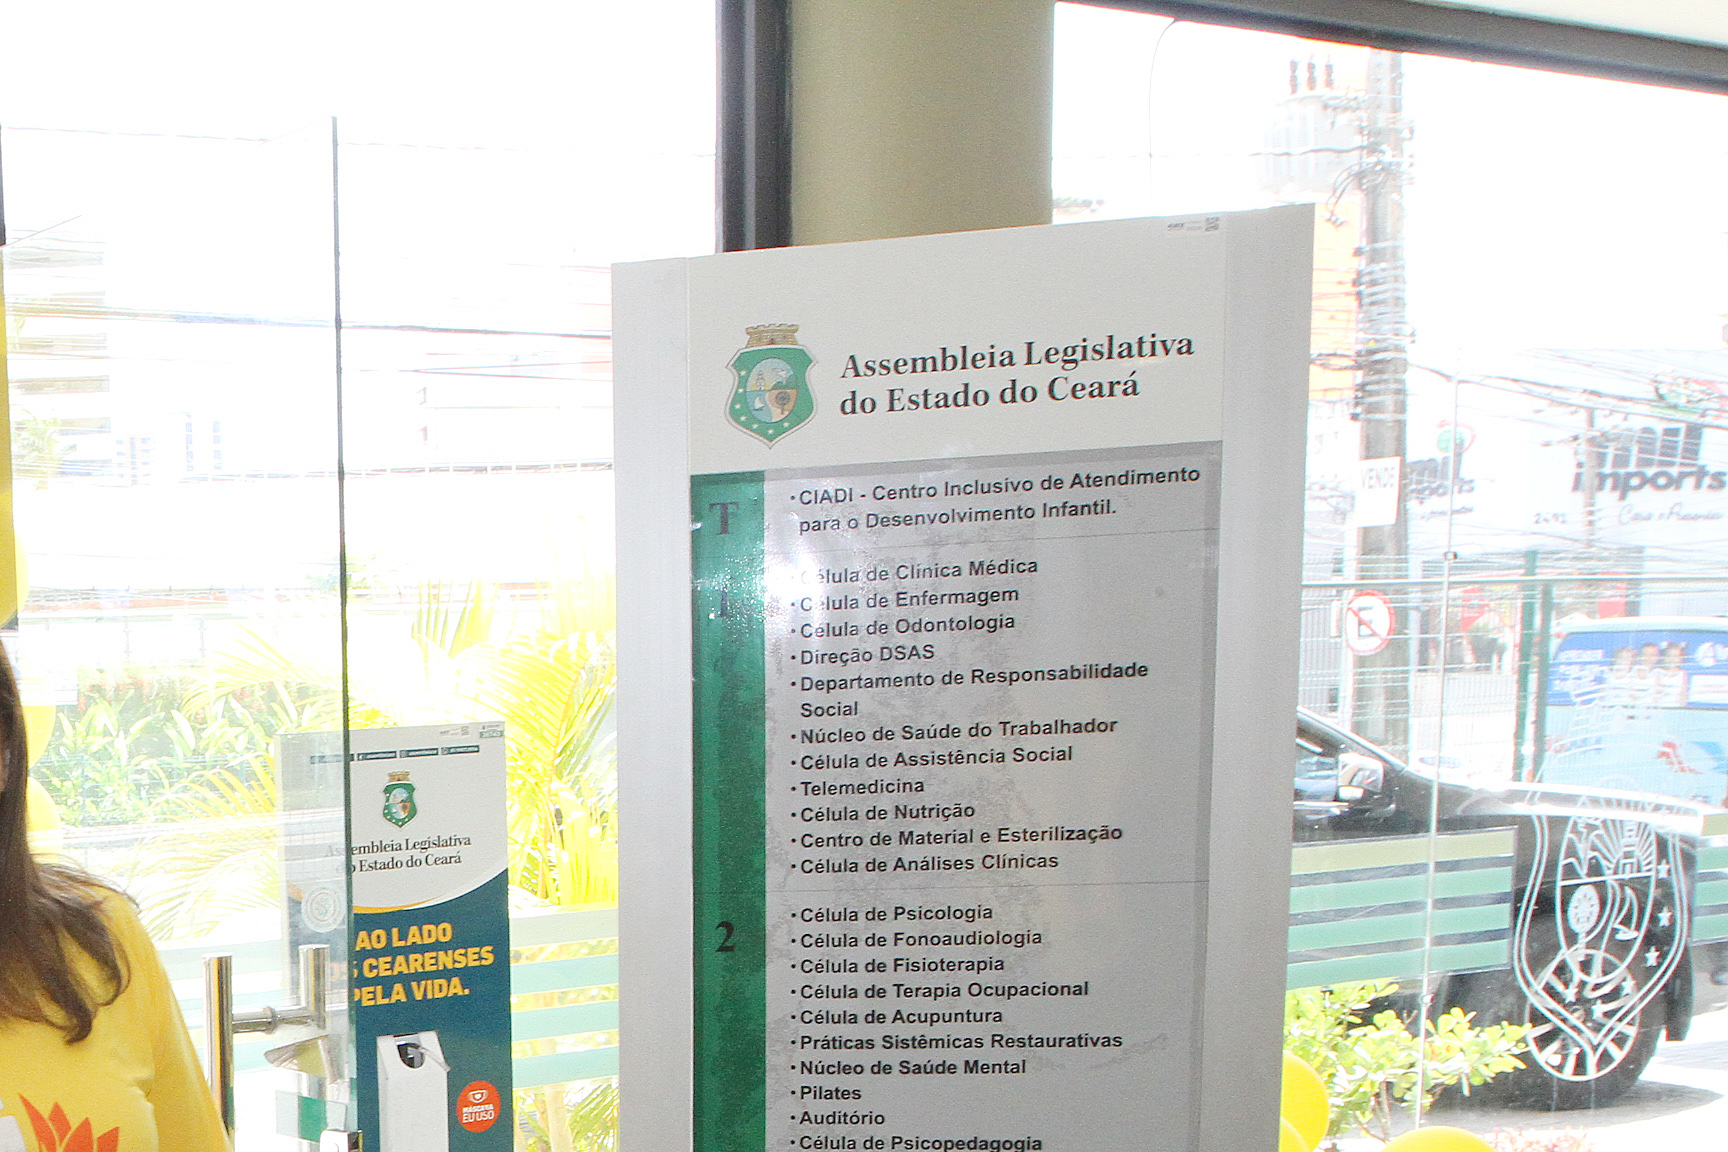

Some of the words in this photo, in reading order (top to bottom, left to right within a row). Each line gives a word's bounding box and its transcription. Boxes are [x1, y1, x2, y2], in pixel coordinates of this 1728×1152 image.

[841, 344, 1016, 380] Assembleia
[1025, 335, 1195, 371] Legislativa
[841, 389, 877, 416] do
[886, 382, 990, 413] Estado
[999, 379, 1038, 404] do
[1048, 371, 1140, 401] Ceará
[799, 489, 853, 506] CIADI
[872, 484, 937, 501] Centro
[944, 478, 1033, 496] Inclusivo
[1041, 474, 1064, 490] de
[1070, 467, 1200, 488] Atendimento
[708, 502, 739, 536] T
[799, 517, 840, 535] para
[848, 518, 859, 530] o
[867, 504, 1035, 528] Desenvolvimento
[1042, 500, 1116, 518] Infantil.
[866, 566, 889, 581] de
[896, 561, 962, 579] Clínica
[969, 559, 1038, 576] Médica
[866, 593, 889, 608] de
[896, 587, 1019, 606] Enfermagem
[800, 621, 859, 638] Célula
[866, 620, 888, 635] de
[896, 615, 1015, 633] Odontologia
[801, 648, 872, 667] Direção
[881, 644, 935, 660] DSAS
[801, 671, 935, 694] Departamento
[942, 670, 964, 686] de
[972, 662, 1148, 688] Responsabilidade
[801, 701, 858, 717] Social
[801, 727, 865, 744] Núcleo
[873, 725, 895, 741] de
[901, 723, 961, 740] Saúde
[968, 722, 992, 738] do
[999, 718, 1118, 736] Trabalhador
[801, 753, 859, 770] Célula
[866, 752, 888, 768] de
[894, 747, 1006, 767] Assistência
[1012, 746, 1072, 763] Social
[801, 779, 924, 796] Telemedicina
[801, 805, 859, 822] Célula
[866, 804, 887, 820] de
[895, 802, 975, 822] Nutrição
[325, 841, 402, 857] Asembleia
[405, 835, 471, 852] Legislativa
[801, 832, 863, 848] Centro
[870, 831, 892, 846] de
[898, 828, 973, 845] Material
[980, 832, 991, 843] e
[998, 825, 1122, 846] Esterilização
[359, 857, 403, 872] Estado
[406, 855, 422, 868] do
[425, 851, 461, 866] Ceará
[801, 857, 859, 874] Célula
[866, 856, 887, 871] de
[893, 853, 974, 871] Análises
[982, 852, 1058, 869] Clínicas
[800, 906, 858, 923] Célula
[865, 905, 887, 921] de
[894, 904, 992, 924] Psicologia
[356, 929, 388, 950] AO
[392, 922, 453, 947] LADO
[715, 921, 735, 952] 2
[800, 932, 858, 948] Célula
[865, 931, 887, 947] de
[894, 929, 1042, 949] Fonoaudiologia
[363, 946, 495, 978] CEARENSES
[800, 958, 858, 974] Célula
[865, 957, 887, 973] de
[894, 956, 1005, 977] Fisioterapia
[411, 977, 470, 1000] VIDA.
[800, 984, 858, 999] Célula
[865, 983, 887, 998] de
[893, 983, 961, 1002] Terapia
[968, 981, 1089, 1000] Ocupacional
[800, 1009, 858, 1025] Célula
[865, 1009, 885, 1024] de
[892, 1009, 1002, 1027] Acupuntura
[800, 1034, 874, 1050] Práticas
[882, 1033, 984, 1050] Sistêmicas
[991, 1033, 1122, 1049] Restaurativas
[800, 1059, 864, 1076] Núcleo
[871, 1059, 892, 1075] de
[899, 1059, 957, 1074] Saúde
[964, 1059, 1026, 1074] Mental
[800, 1085, 862, 1101] Pilates
[463, 1113, 475, 1123] EU
[476, 1110, 494, 1121] USO
[800, 1110, 885, 1126] Auditório
[800, 1135, 857, 1151] Célula
[863, 1135, 885, 1151] de
